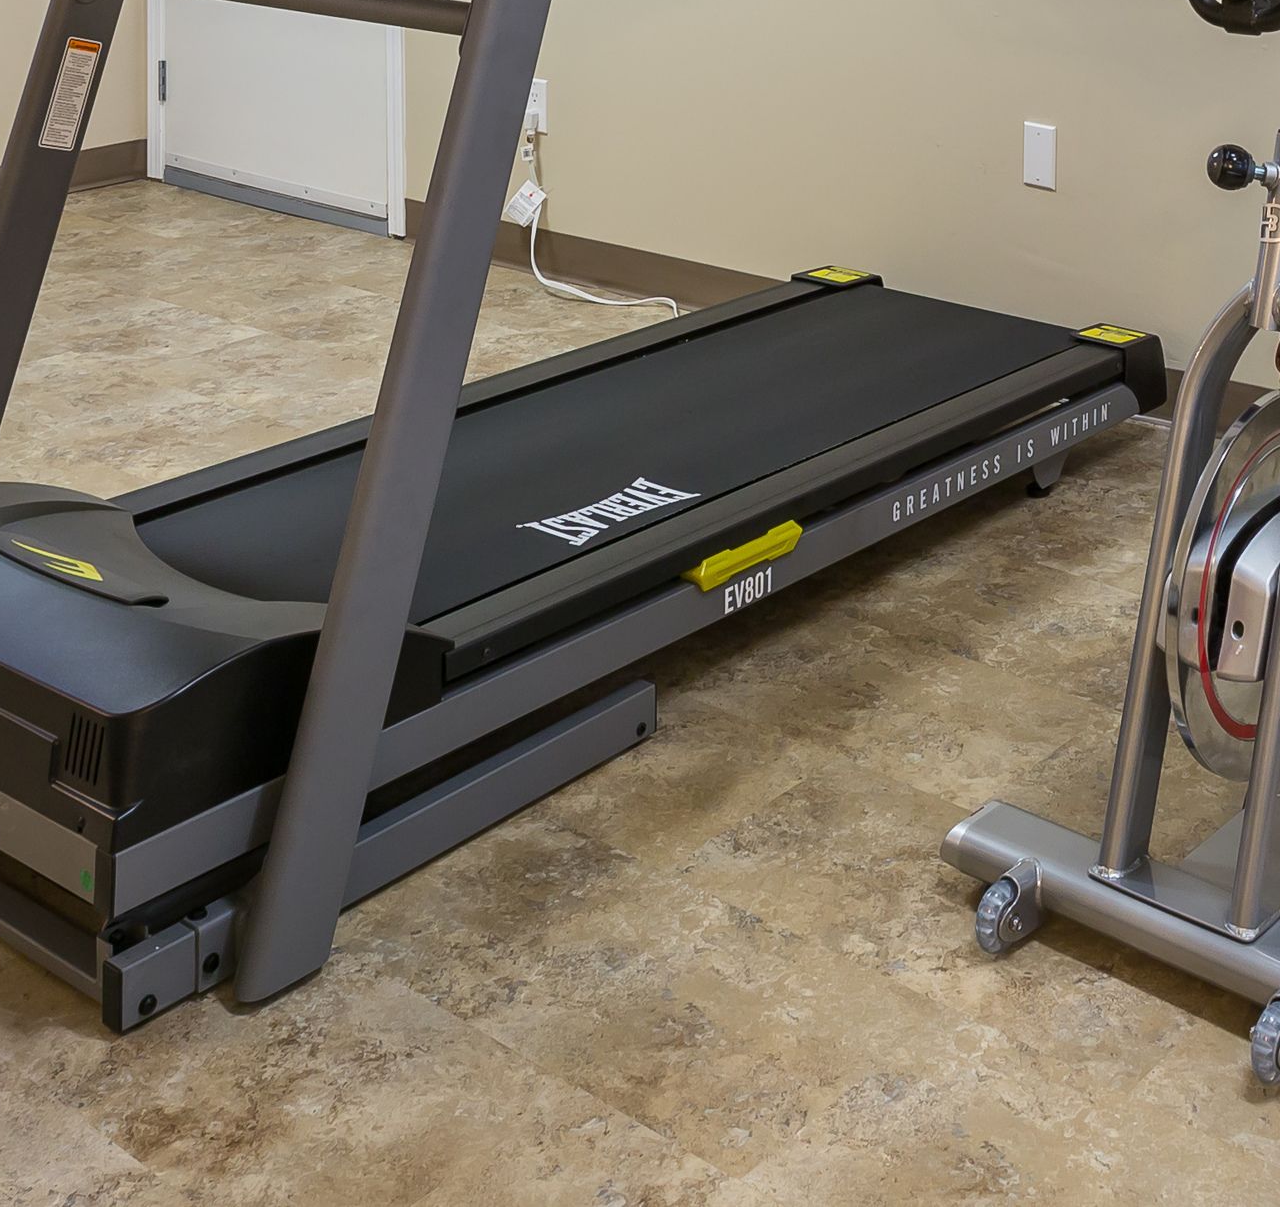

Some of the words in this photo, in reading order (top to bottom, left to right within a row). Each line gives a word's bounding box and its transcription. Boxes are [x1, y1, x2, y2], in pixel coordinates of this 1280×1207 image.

[892, 454, 1001, 522] GREATNESS
[1017, 439, 1034, 464] IS
[1050, 403, 1108, 446] WITHIN
[523, 477, 702, 546] EVERLAST
[724, 566, 772, 615] EV801
